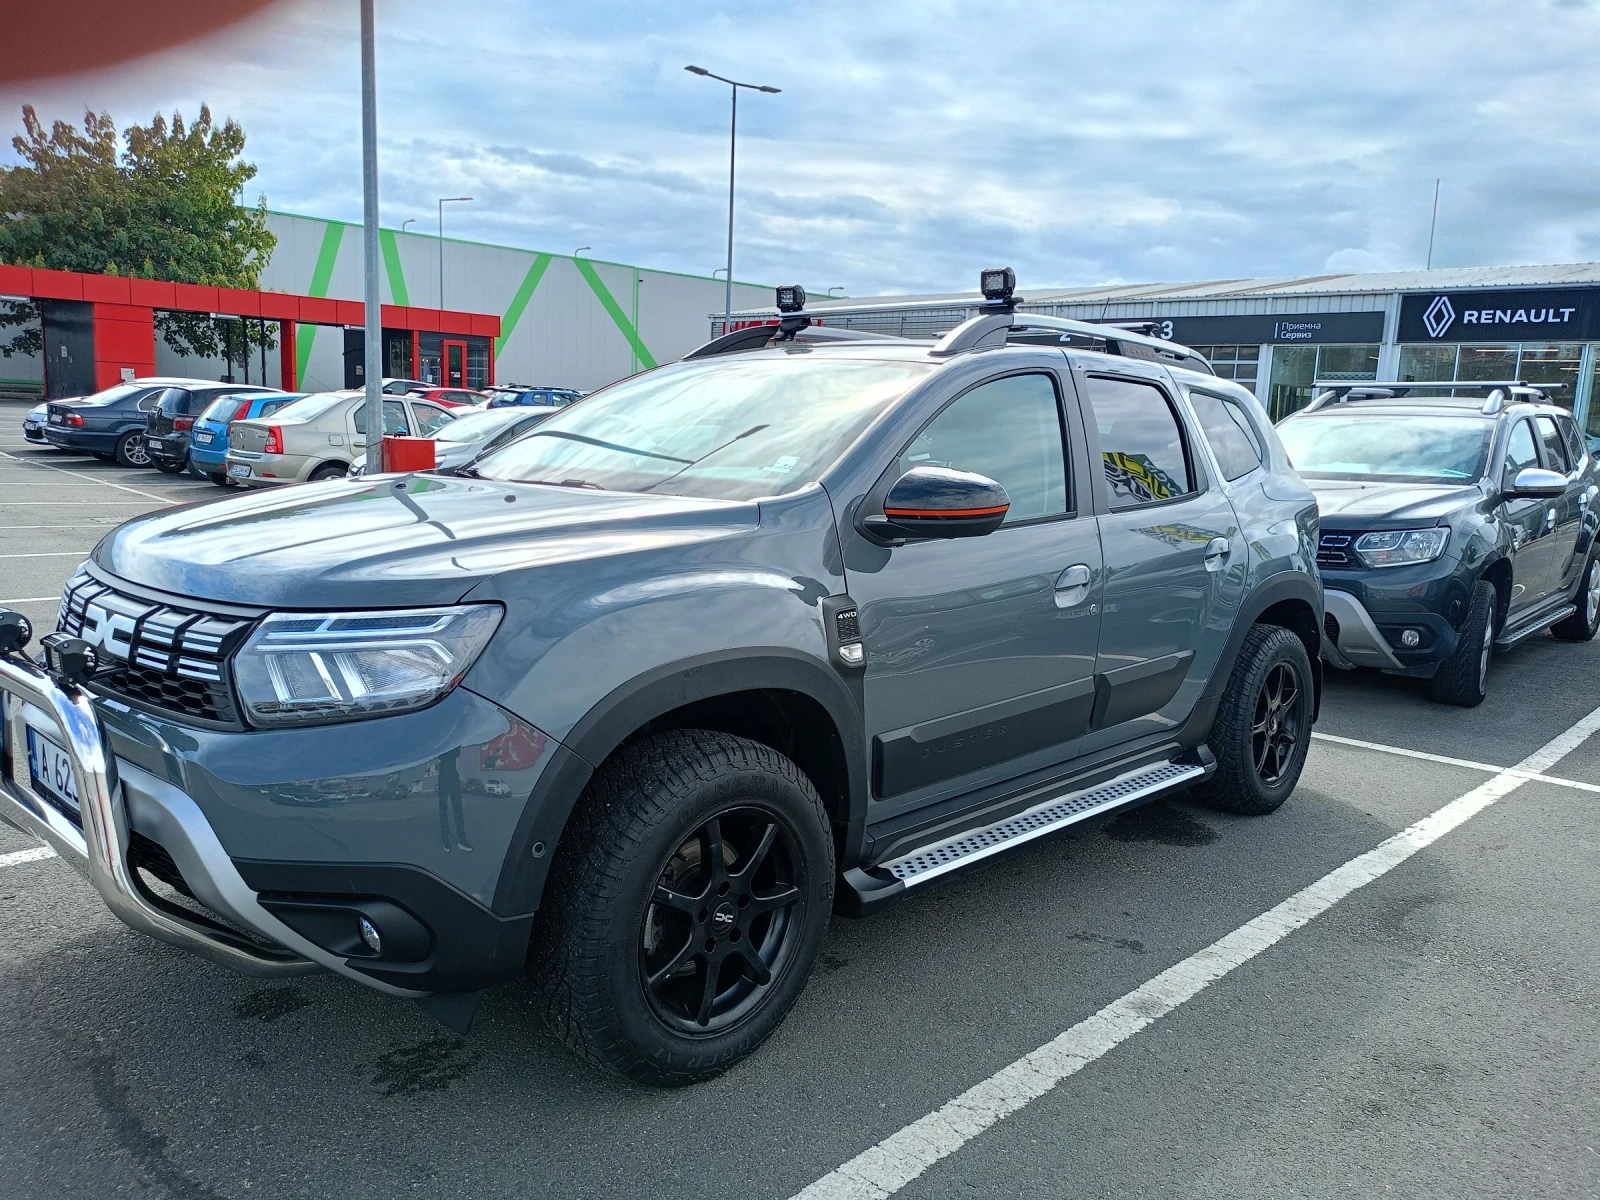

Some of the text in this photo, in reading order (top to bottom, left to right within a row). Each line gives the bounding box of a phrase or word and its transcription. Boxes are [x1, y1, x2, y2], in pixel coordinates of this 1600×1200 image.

[1463, 307, 1576, 325] RENAULT
[1160, 320, 1174, 340] 3
[1280, 330, 1312, 340] Сервиз
[1281, 321, 1322, 332] Приемна
[837, 611, 857, 620] 4WD
[921, 724, 1009, 759] DUSTER
[42, 743, 79, 803] A 62
[677, 775, 791, 824] GENERAL
